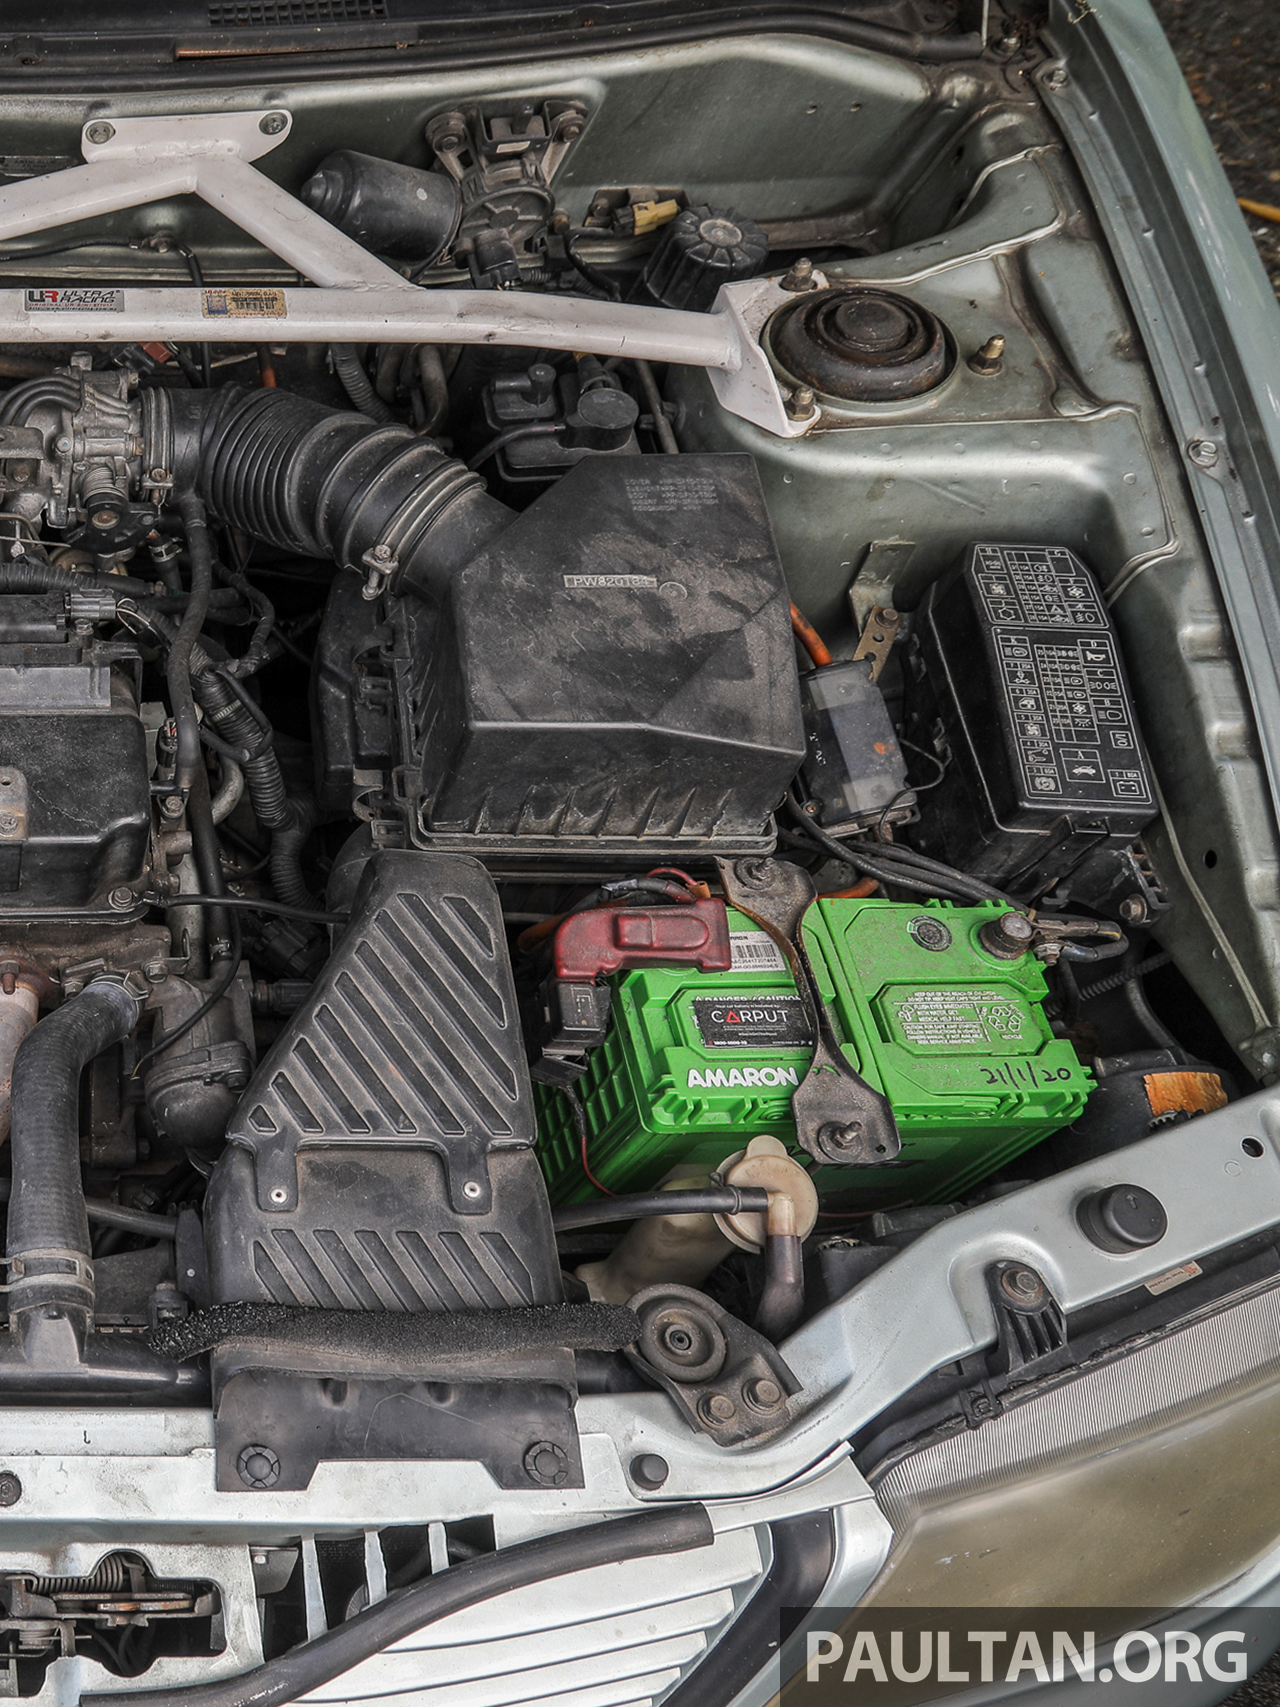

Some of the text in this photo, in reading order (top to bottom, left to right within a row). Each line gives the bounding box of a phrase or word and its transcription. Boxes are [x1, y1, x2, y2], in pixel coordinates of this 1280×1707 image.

[711, 1010, 788, 1023] CARPUT
[688, 1066, 799, 1088] AMARON
[980, 1060, 1071, 1090] 21/1/20
